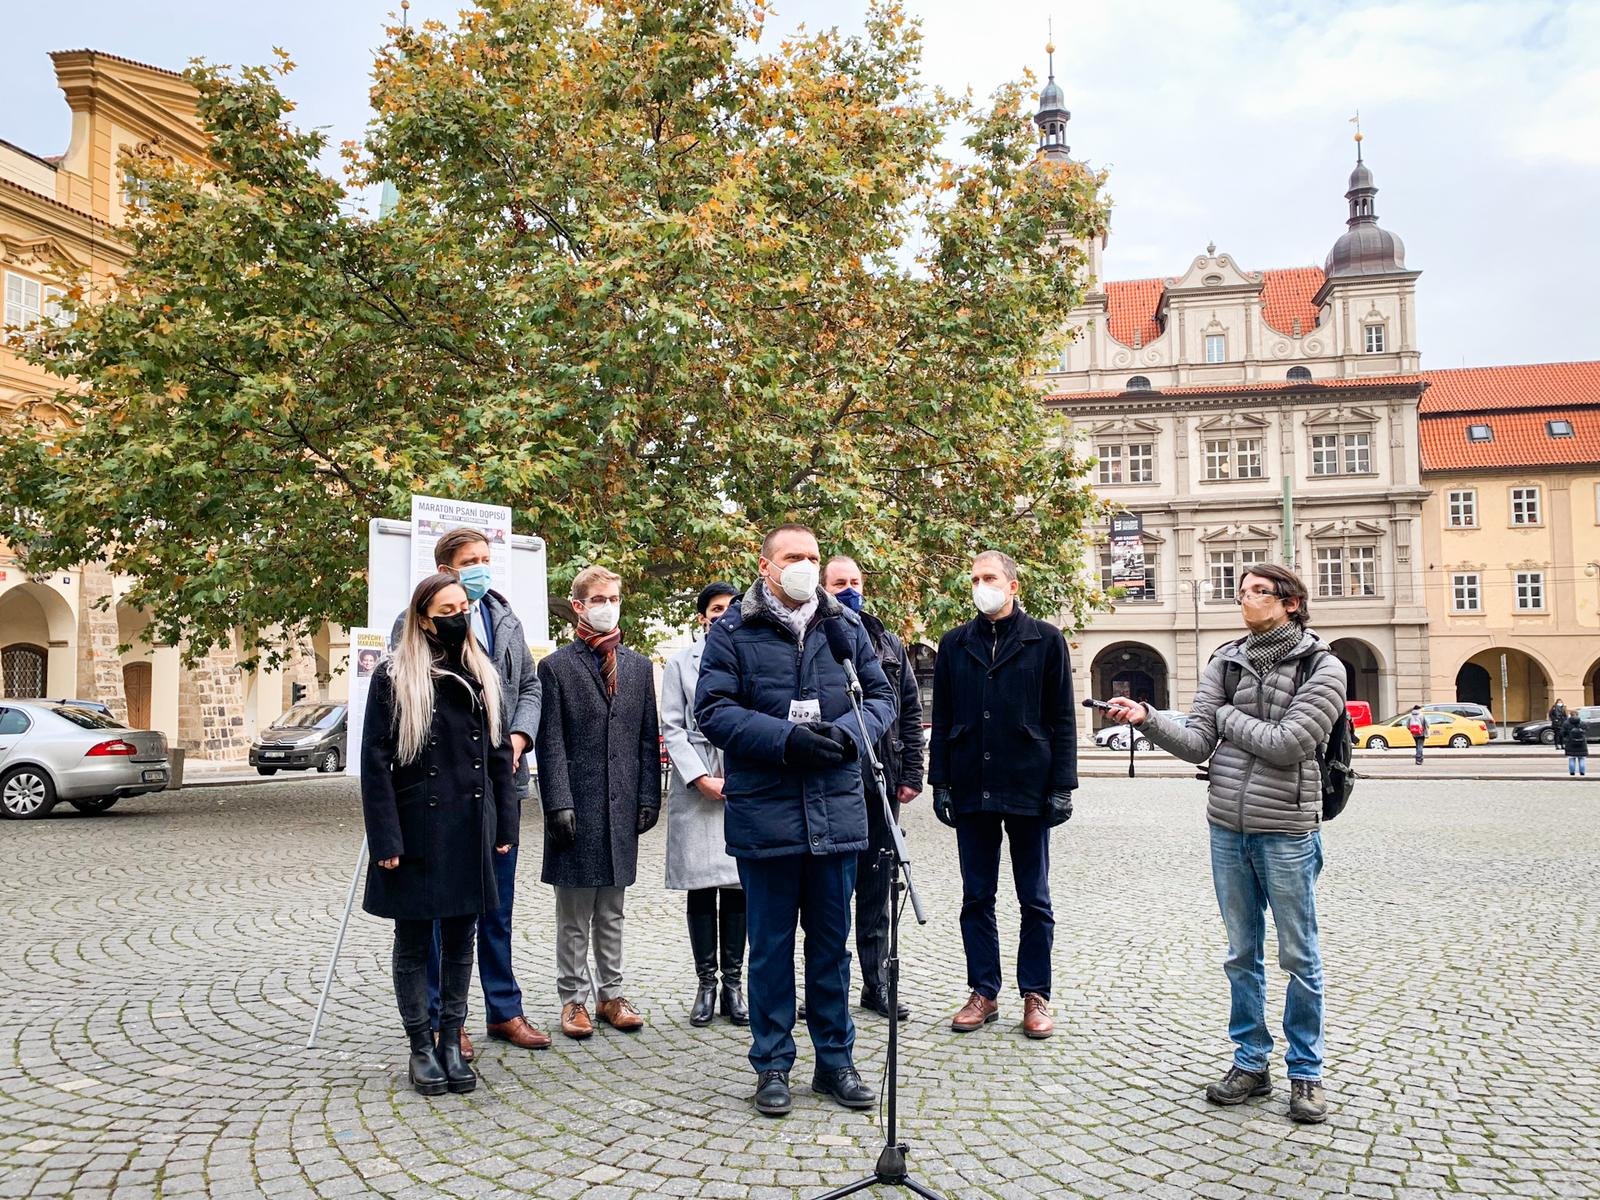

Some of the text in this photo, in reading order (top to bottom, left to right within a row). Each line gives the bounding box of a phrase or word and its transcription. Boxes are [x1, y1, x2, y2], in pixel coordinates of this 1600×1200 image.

[418, 502, 454, 514] MARATON
[455, 506, 478, 517] PSANÍ
[479, 509, 506, 520] DOPISŮ
